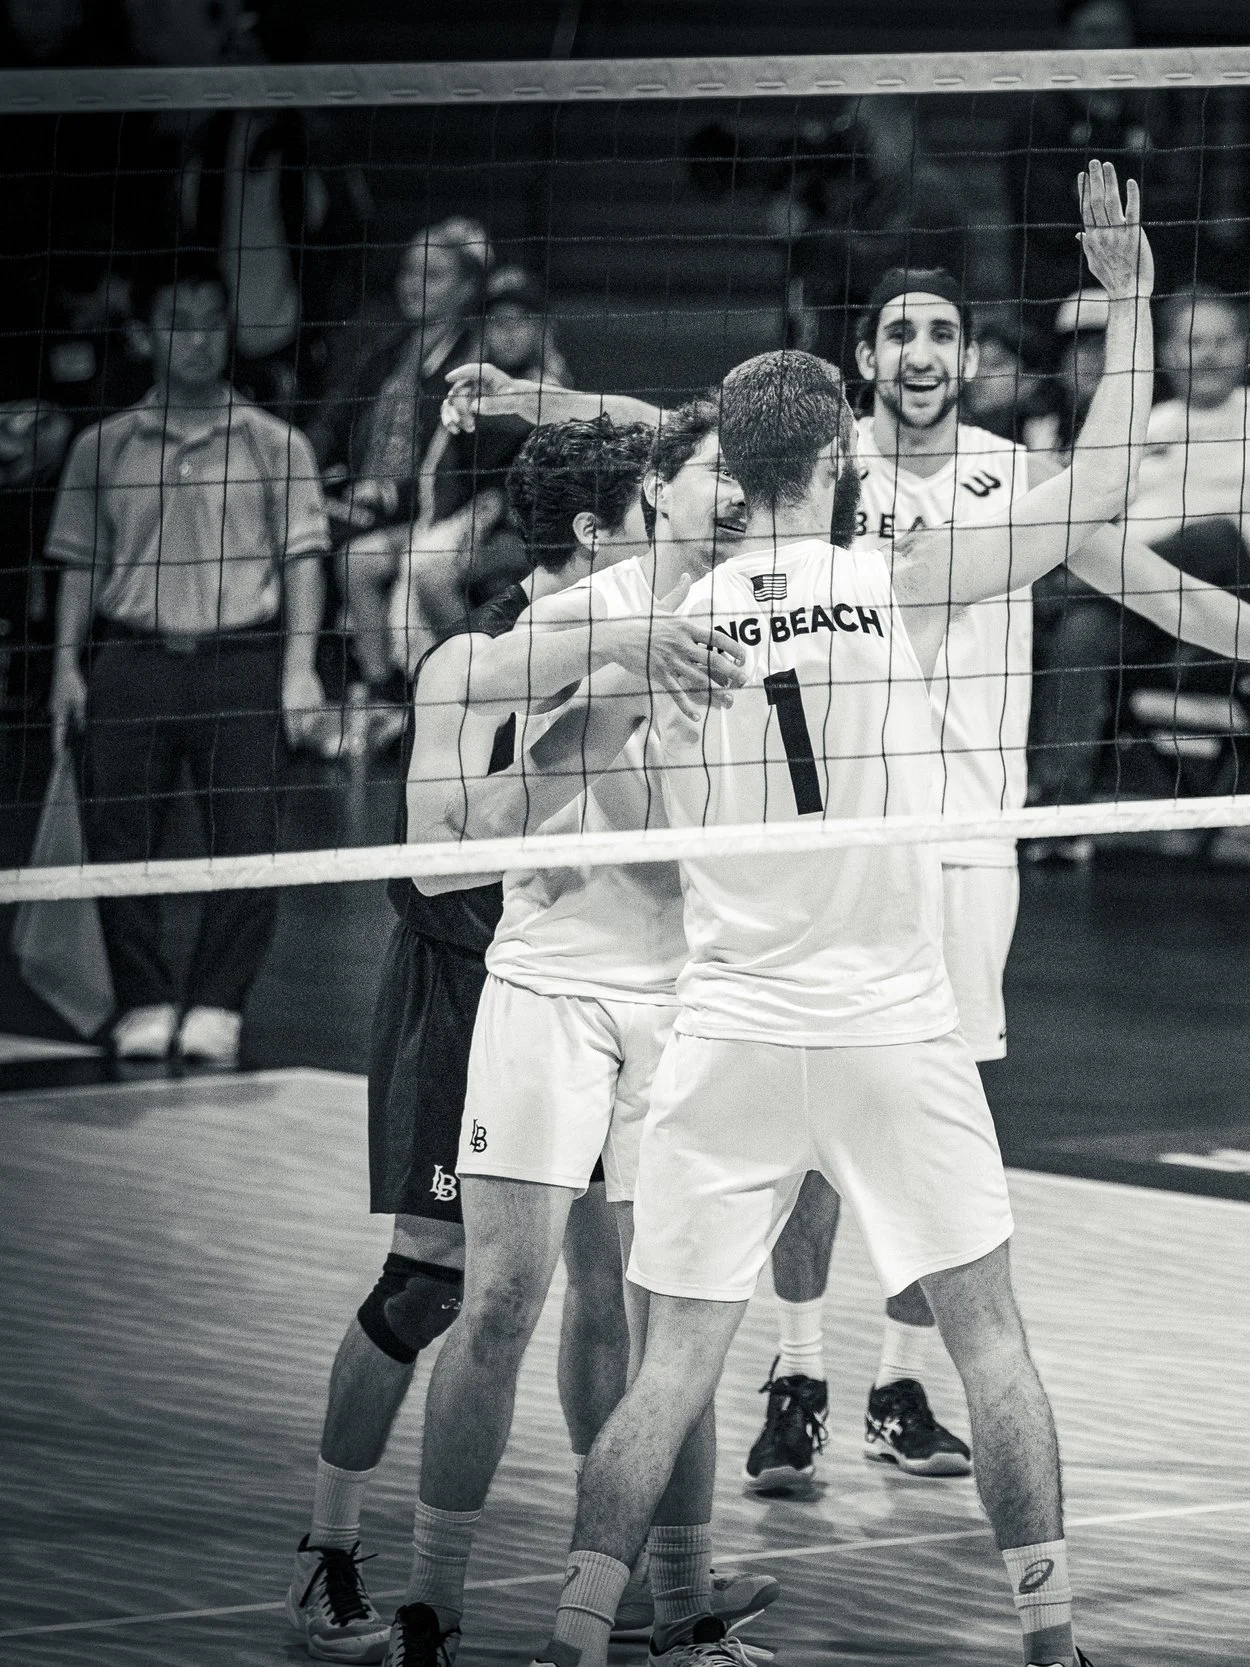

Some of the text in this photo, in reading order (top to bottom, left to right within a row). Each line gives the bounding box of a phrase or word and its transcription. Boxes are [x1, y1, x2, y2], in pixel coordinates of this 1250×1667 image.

[855, 511, 955, 539] BEA
[770, 603, 884, 643] BEACH
[763, 667, 824, 816] 1
[429, 1164, 457, 1201] LB
